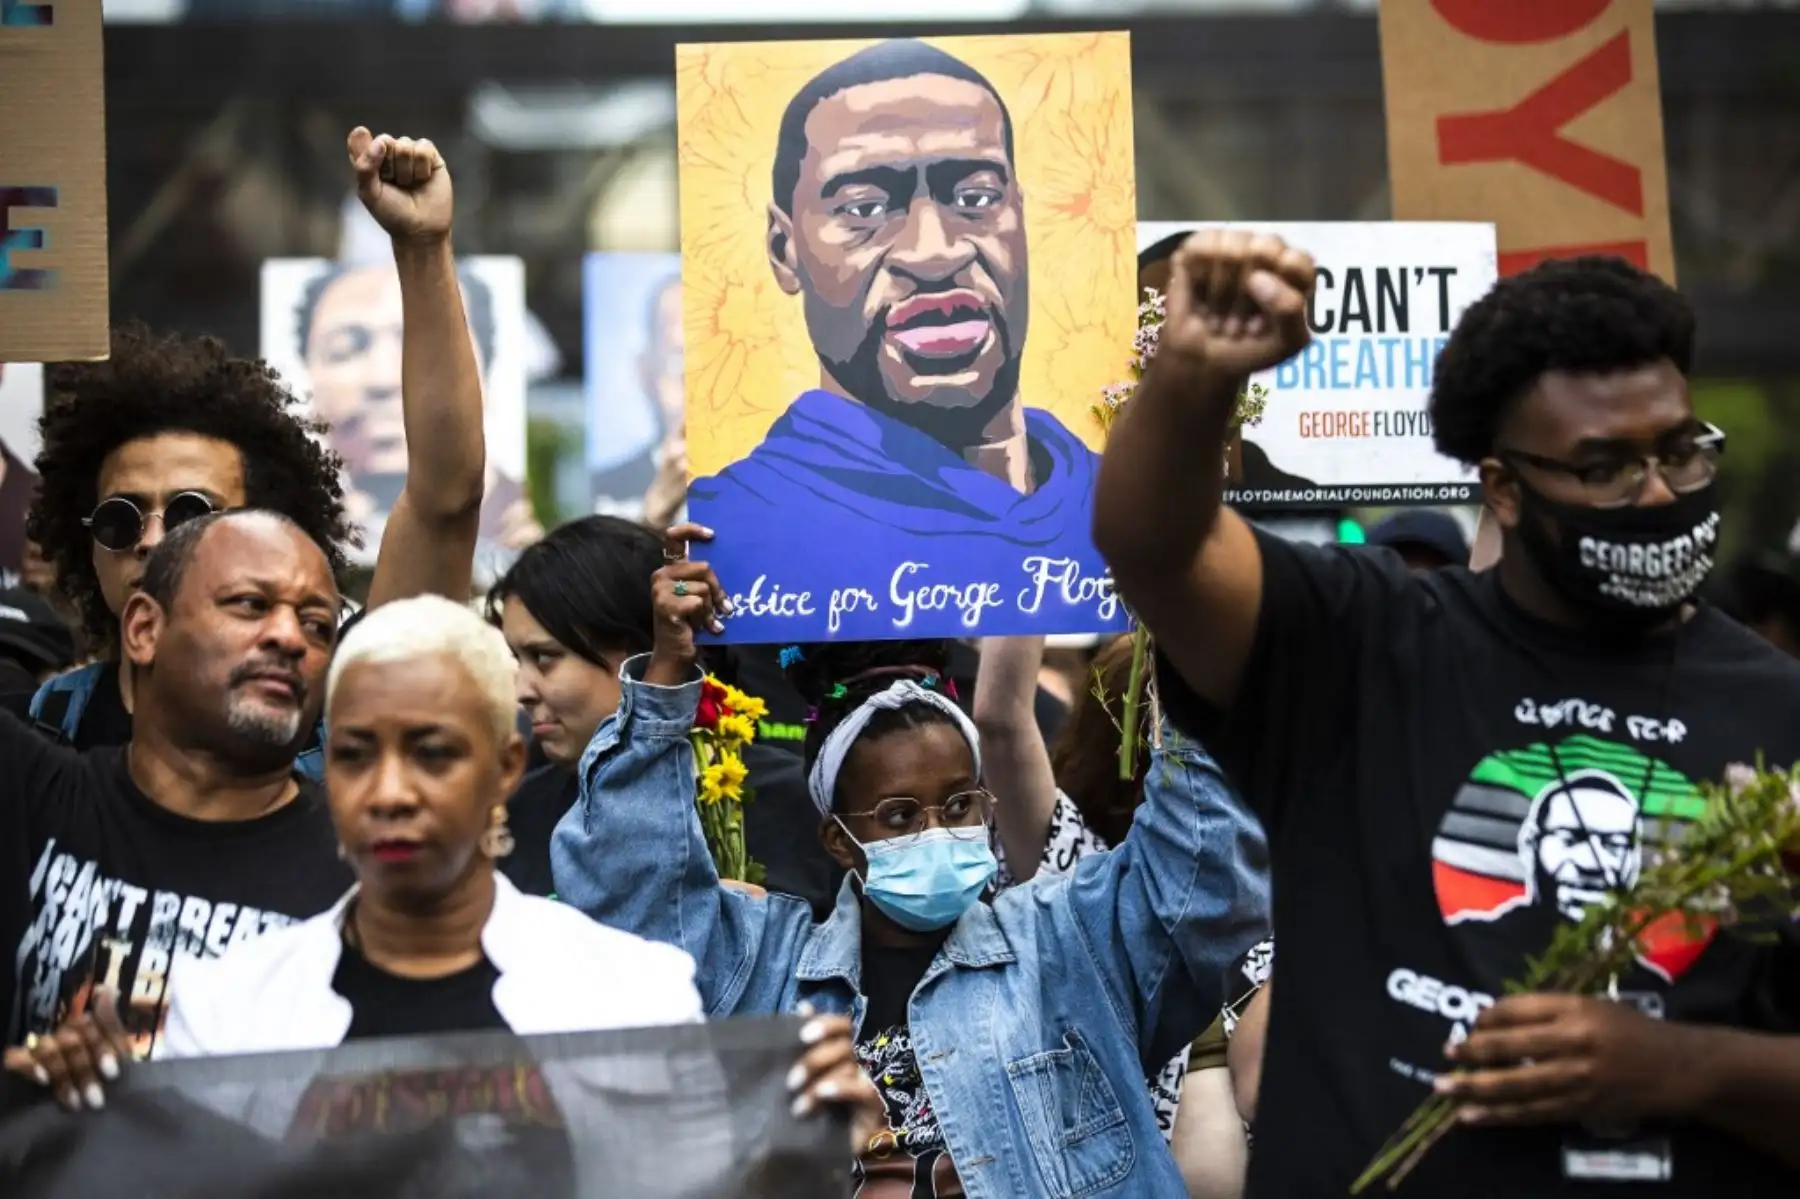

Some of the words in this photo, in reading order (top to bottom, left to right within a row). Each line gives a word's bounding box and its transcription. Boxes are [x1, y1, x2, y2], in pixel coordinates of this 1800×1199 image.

[712, 574, 816, 619] stice
[829, 588, 877, 632] for
[889, 562, 1003, 627] George
[1018, 555, 1118, 620] Floy
[149, 889, 303, 956] BREA
